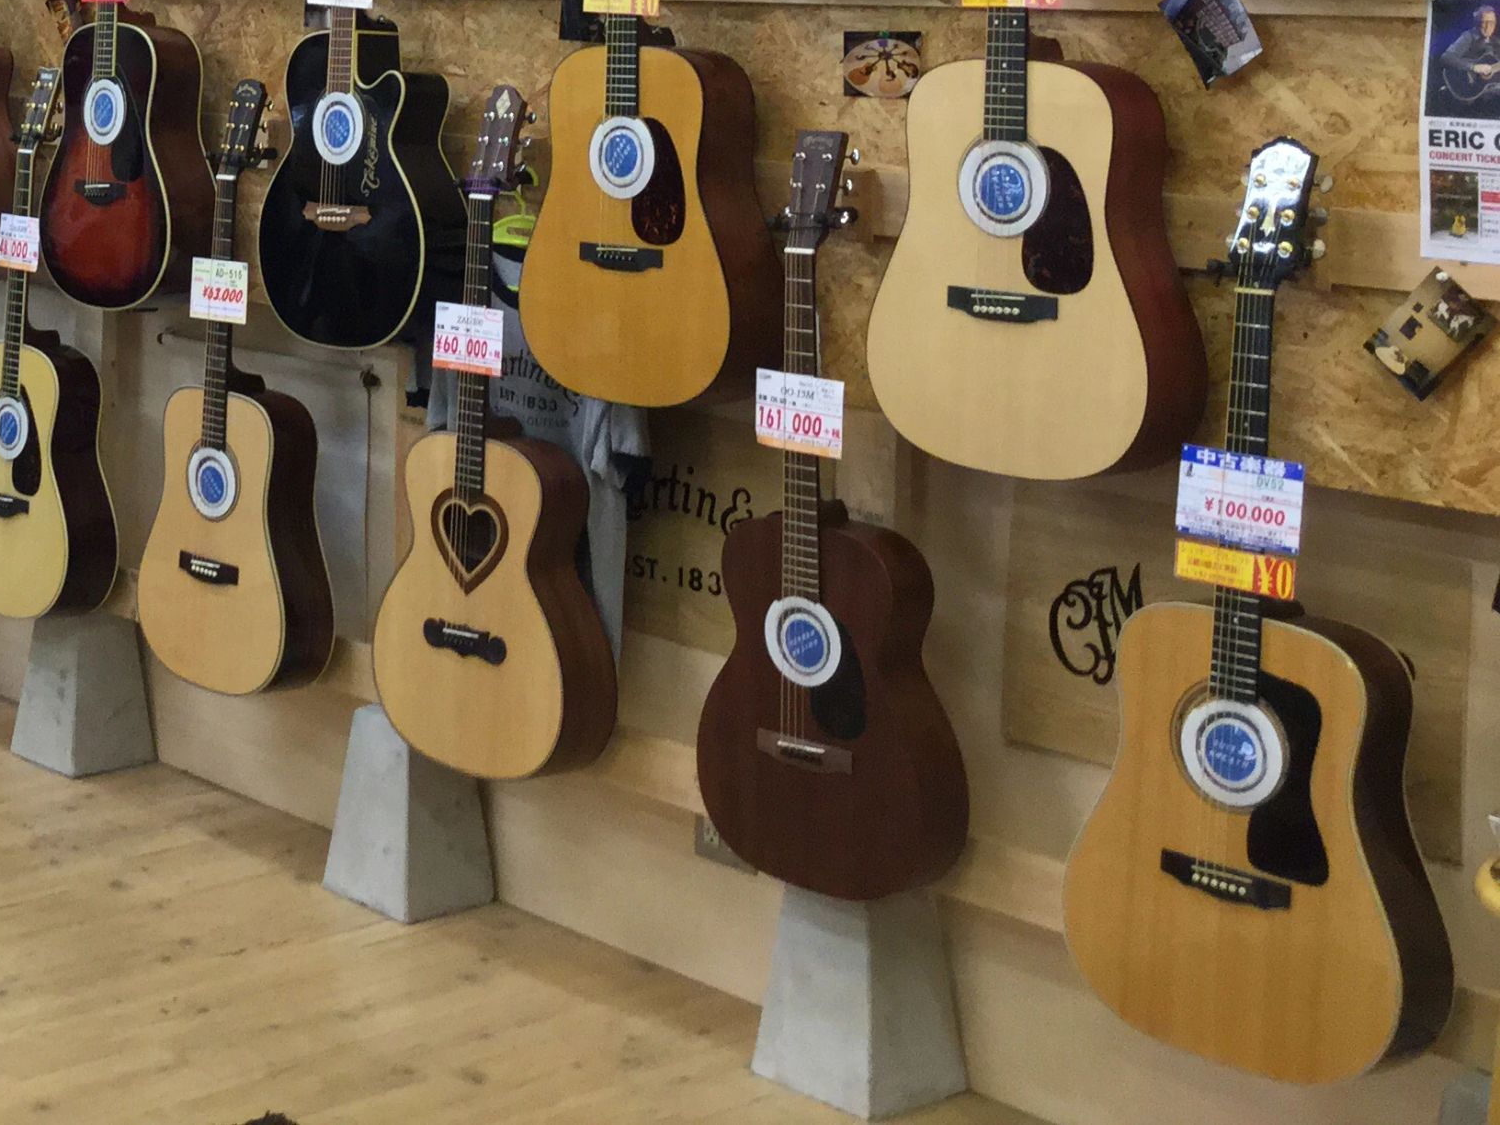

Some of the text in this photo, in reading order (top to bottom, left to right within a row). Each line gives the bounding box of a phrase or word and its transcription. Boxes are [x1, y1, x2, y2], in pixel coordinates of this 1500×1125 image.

[1428, 128, 1485, 151] ERIC
[1428, 150, 1500, 165] CONCERT TICKE
[1254, 555, 1293, 599] ¥0
